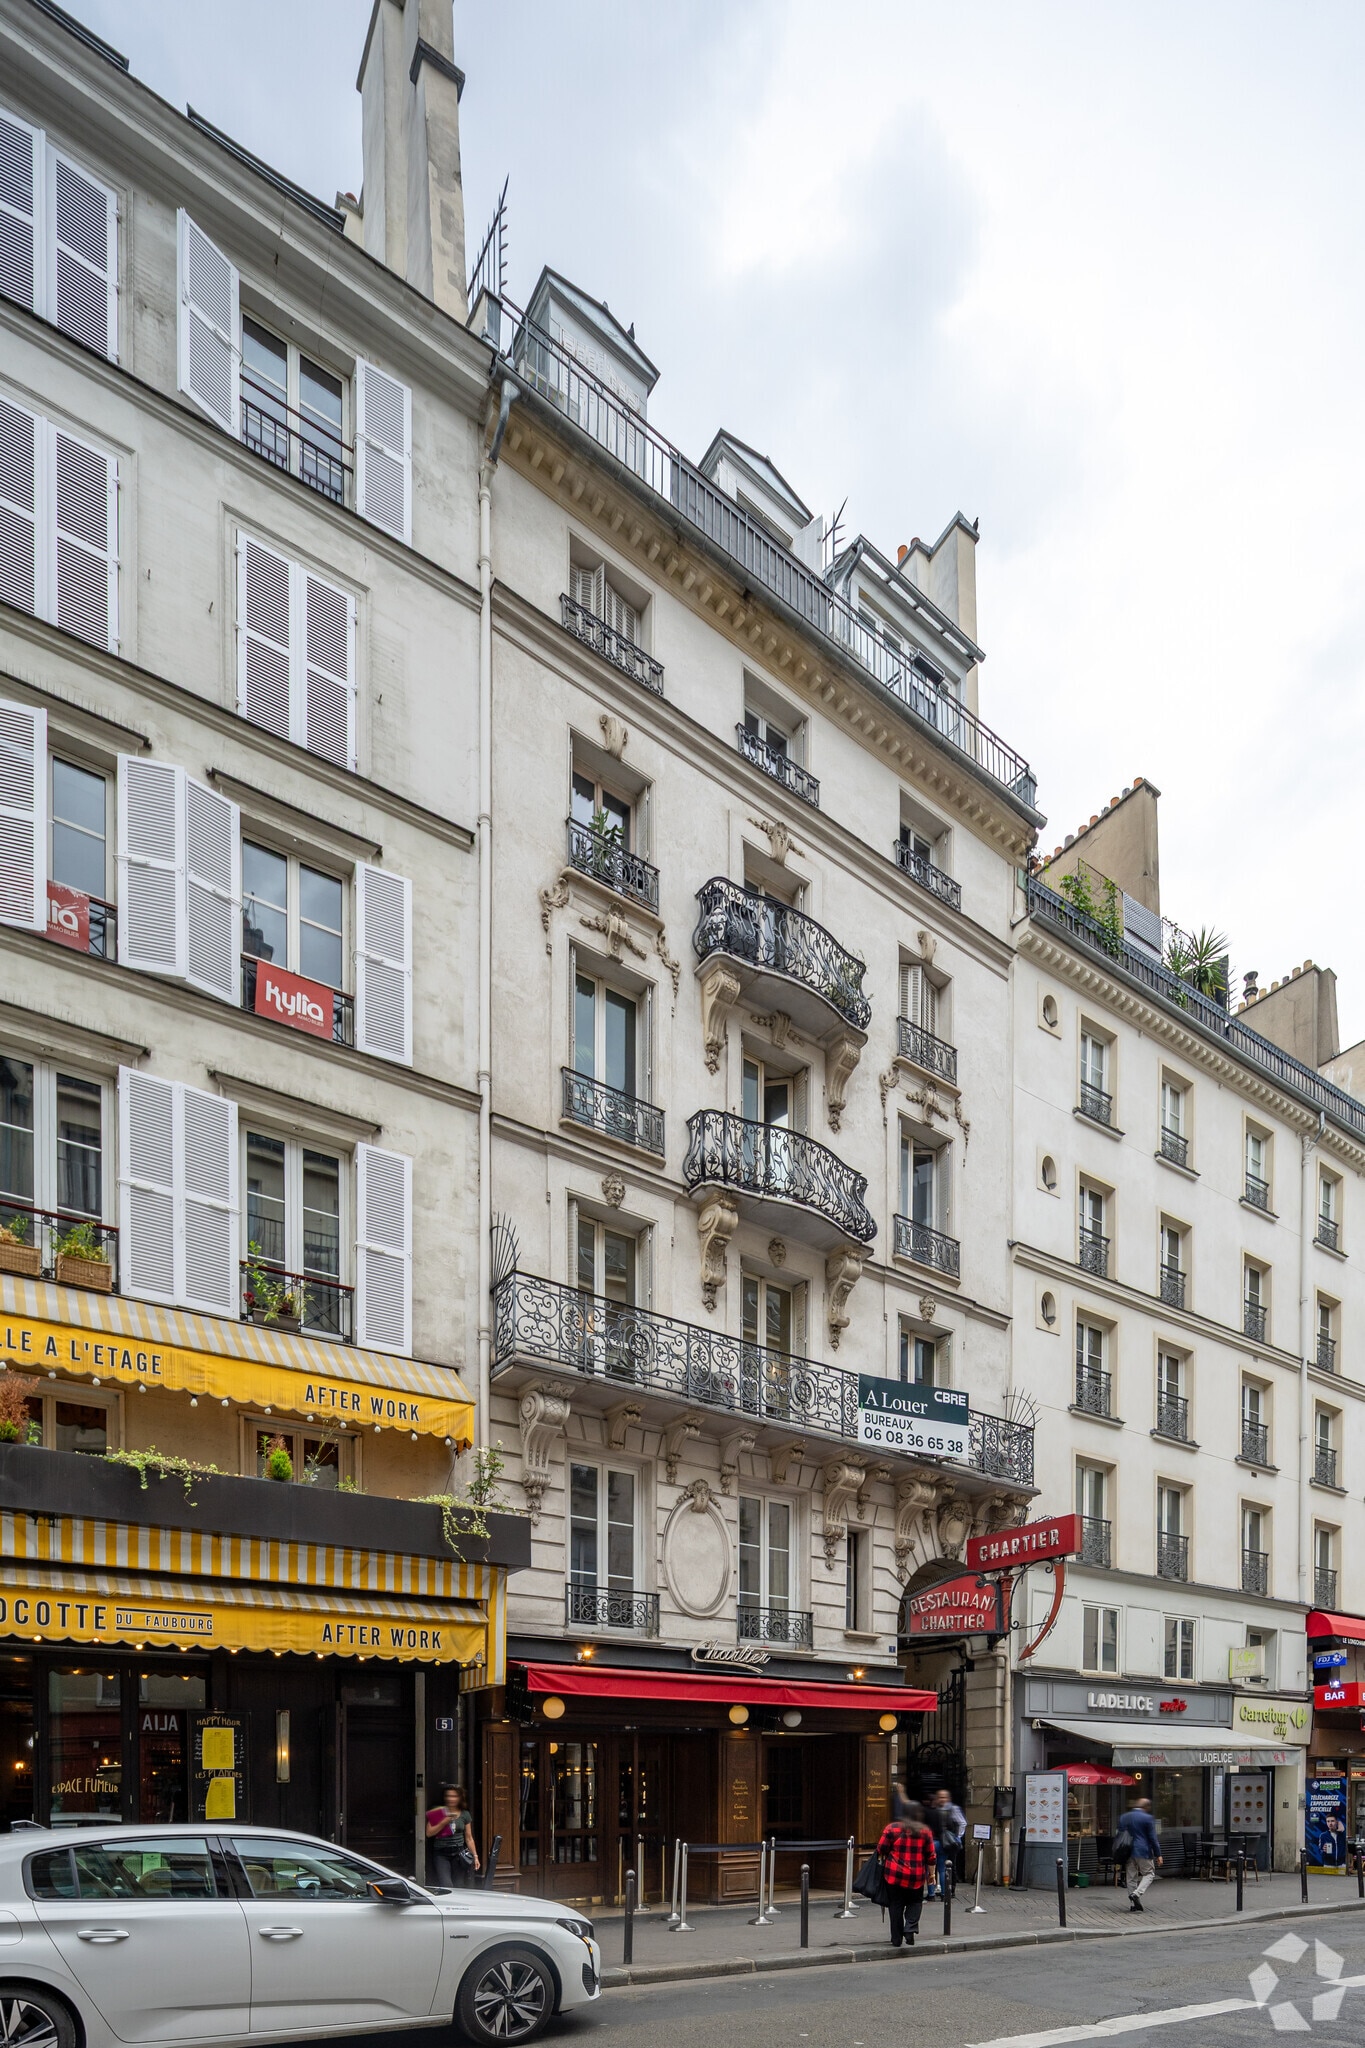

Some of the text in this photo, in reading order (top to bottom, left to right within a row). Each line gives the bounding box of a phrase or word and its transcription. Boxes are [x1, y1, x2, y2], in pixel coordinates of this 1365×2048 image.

[0, 1328, 161, 1375] LE A L'ETAGE
[305, 1384, 420, 1422] AFTER WORK
[864, 1389, 929, 1415] A Louer
[933, 1390, 967, 1407] CBRE
[864, 1412, 914, 1431] BUREAUX
[863, 1426, 882, 1441] 06
[885, 1430, 904, 1444] 08
[907, 1433, 924, 1447] 36
[927, 1436, 944, 1451] 65
[947, 1440, 964, 1454] 38
[978, 1528, 1061, 1563] CHARTIER
[910, 1591, 998, 1616] RESTAURANT
[116, 1613, 133, 1625] DU
[145, 1615, 213, 1630] FAUBOURG
[921, 1613, 985, 1630] CHARTIER
[322, 1623, 442, 1649] AFTER WORK
[690, 1639, 772, 1674] Chartier
[1087, 1692, 1154, 1711] LADELICE
[1324, 1691, 1346, 1701] BAR
[196, 1715, 241, 1726] HAPPY HOUR
[1239, 1704, 1289, 1724] Carrefour
[441, 1719, 448, 1729] 5
[1273, 1724, 1287, 1740] city
[1199, 1752, 1233, 1764] LADELICE
[52, 1778, 119, 1794] ESPACE FUMEUR
